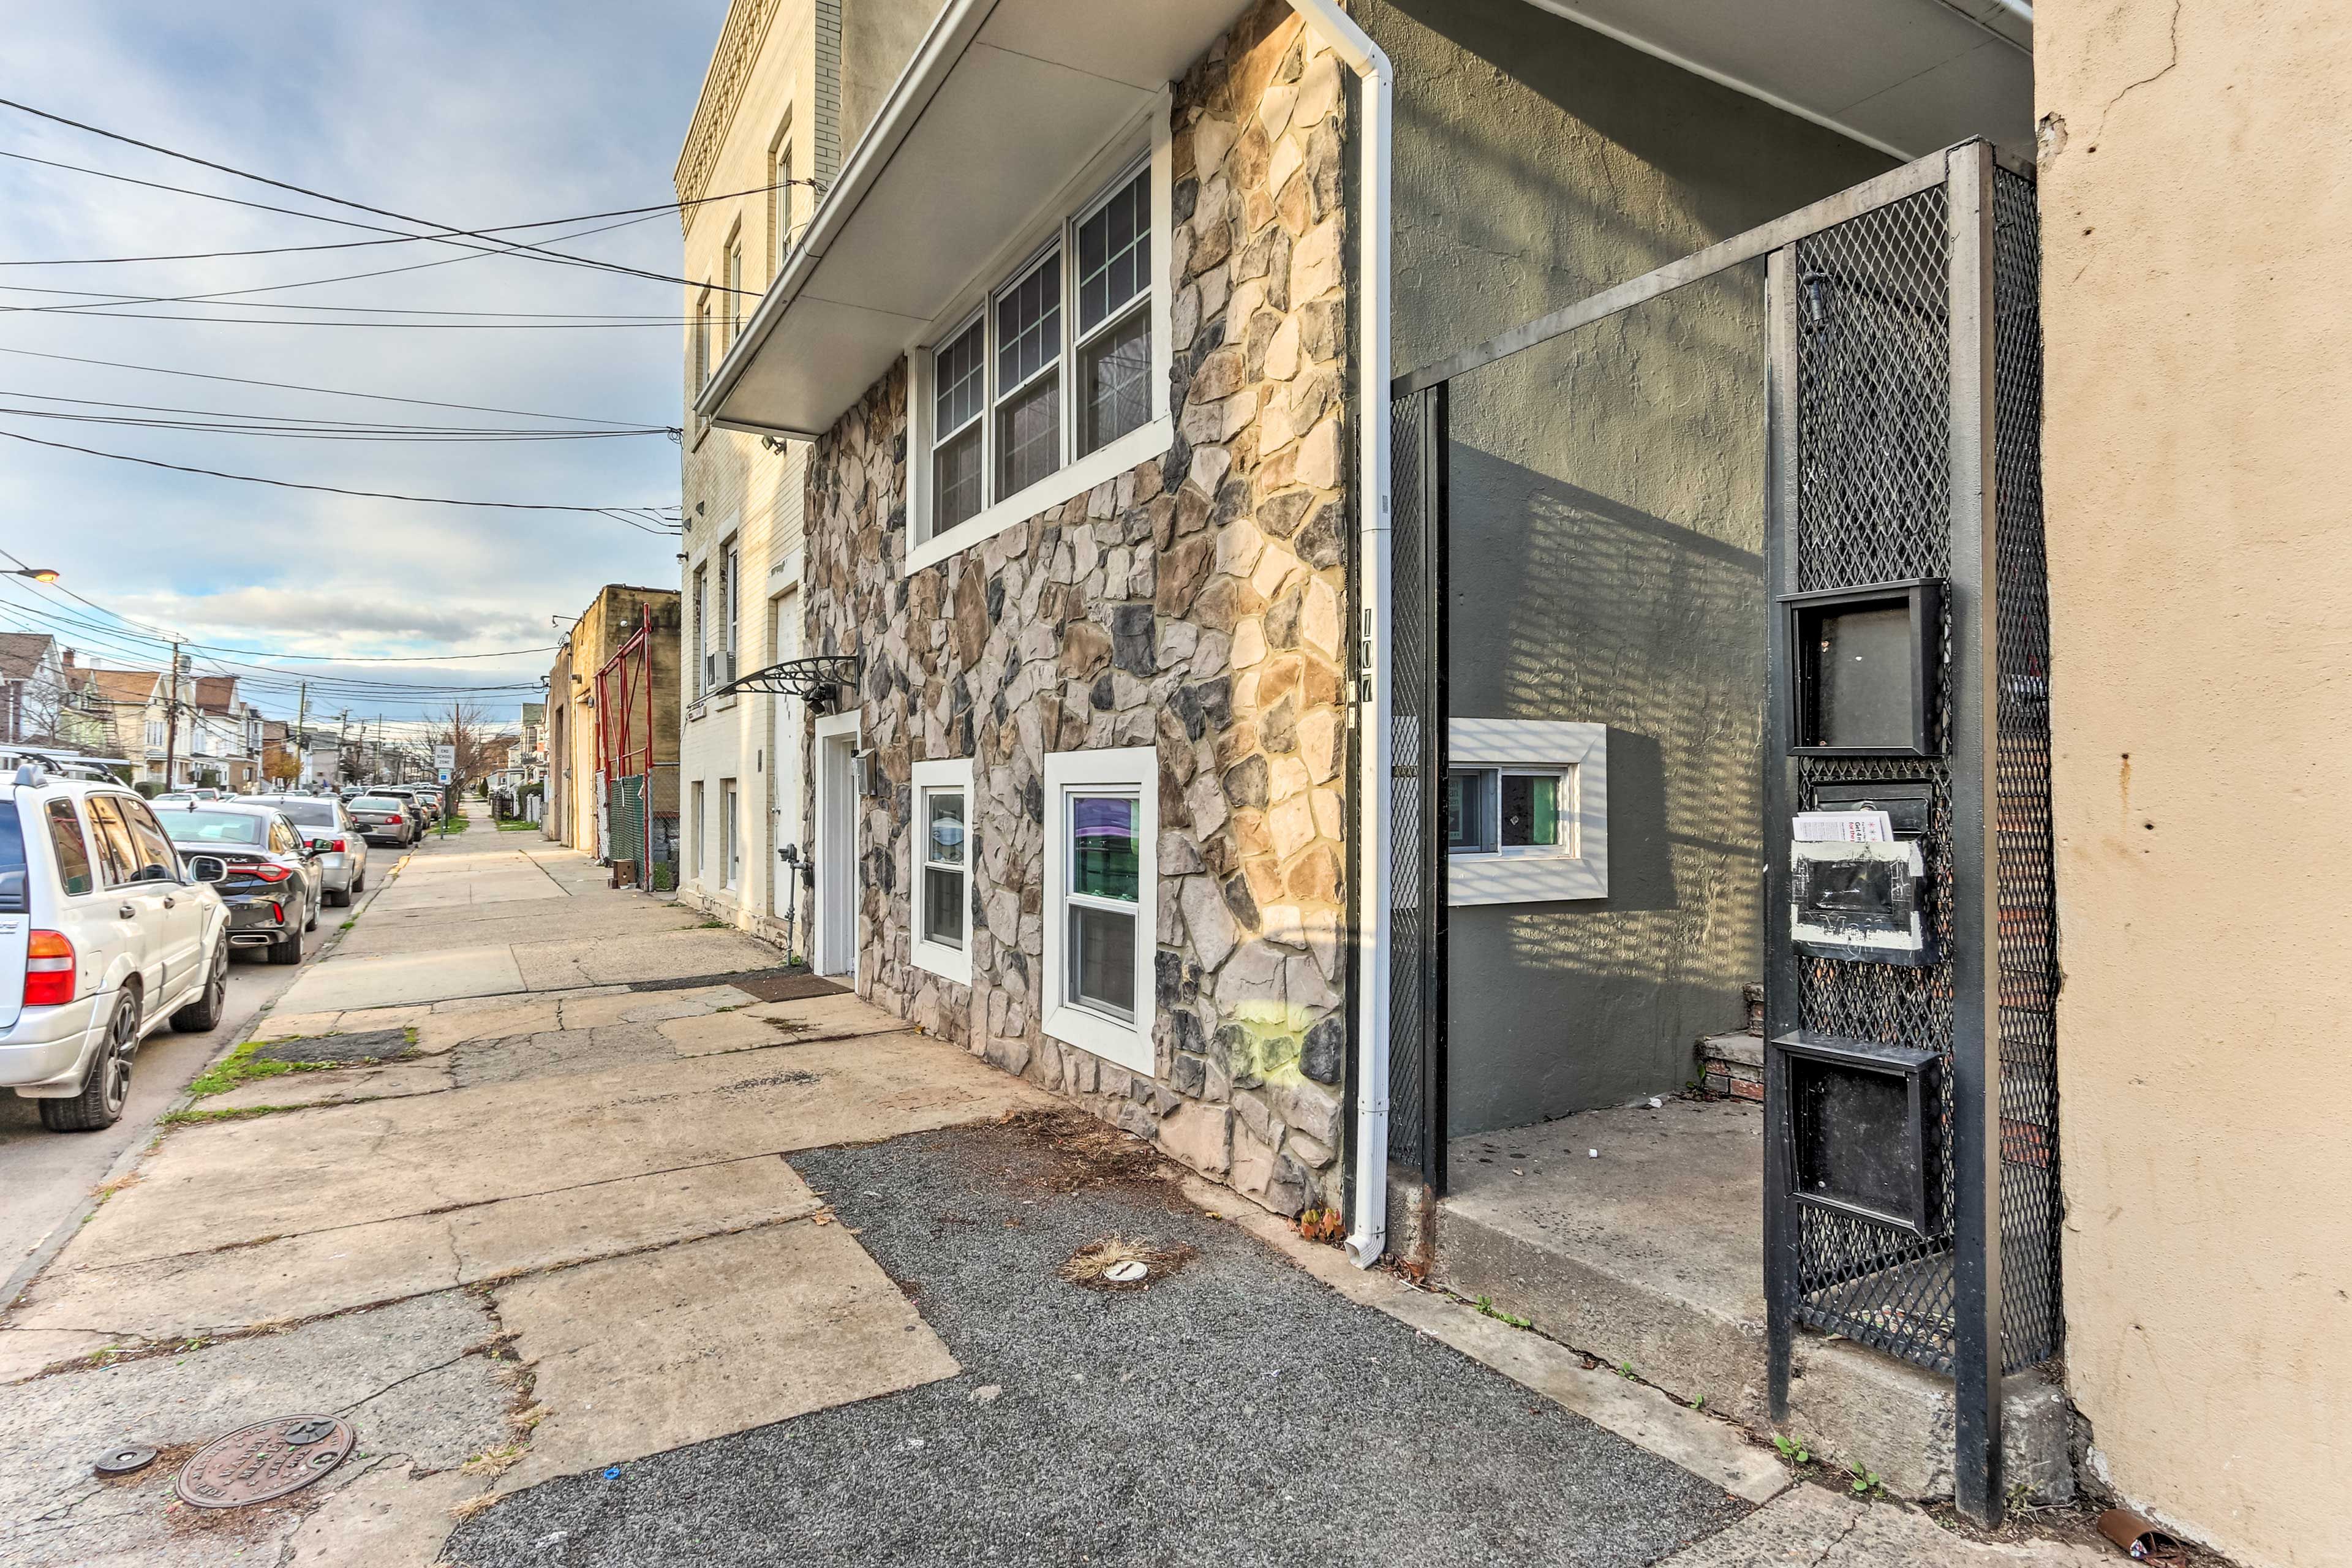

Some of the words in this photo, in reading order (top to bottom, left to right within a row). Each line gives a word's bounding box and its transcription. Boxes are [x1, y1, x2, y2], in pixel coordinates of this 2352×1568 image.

[1362, 609, 1372, 702] 107
[192, 1444, 228, 1480] METER
[218, 1436, 271, 1478] WATER
